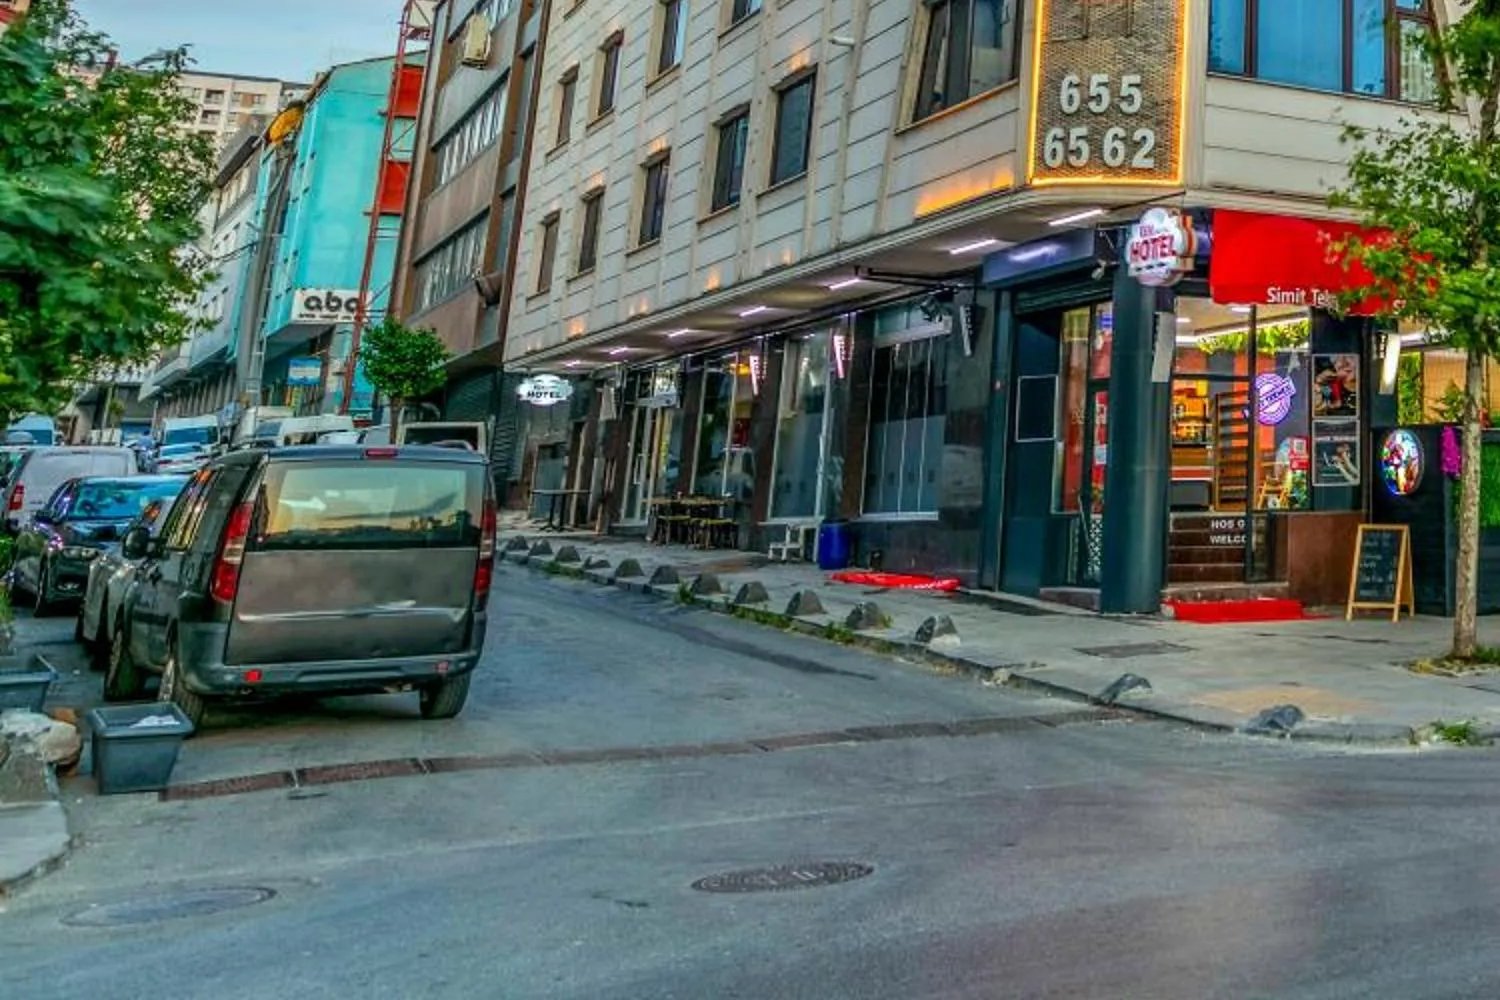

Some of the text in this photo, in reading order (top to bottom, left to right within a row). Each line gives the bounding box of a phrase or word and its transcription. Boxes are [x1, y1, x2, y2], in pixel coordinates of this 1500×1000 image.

[1059, 73, 1143, 115] 655
[1130, 235, 1177, 262] HOTEL
[1266, 286, 1306, 304] Simit
